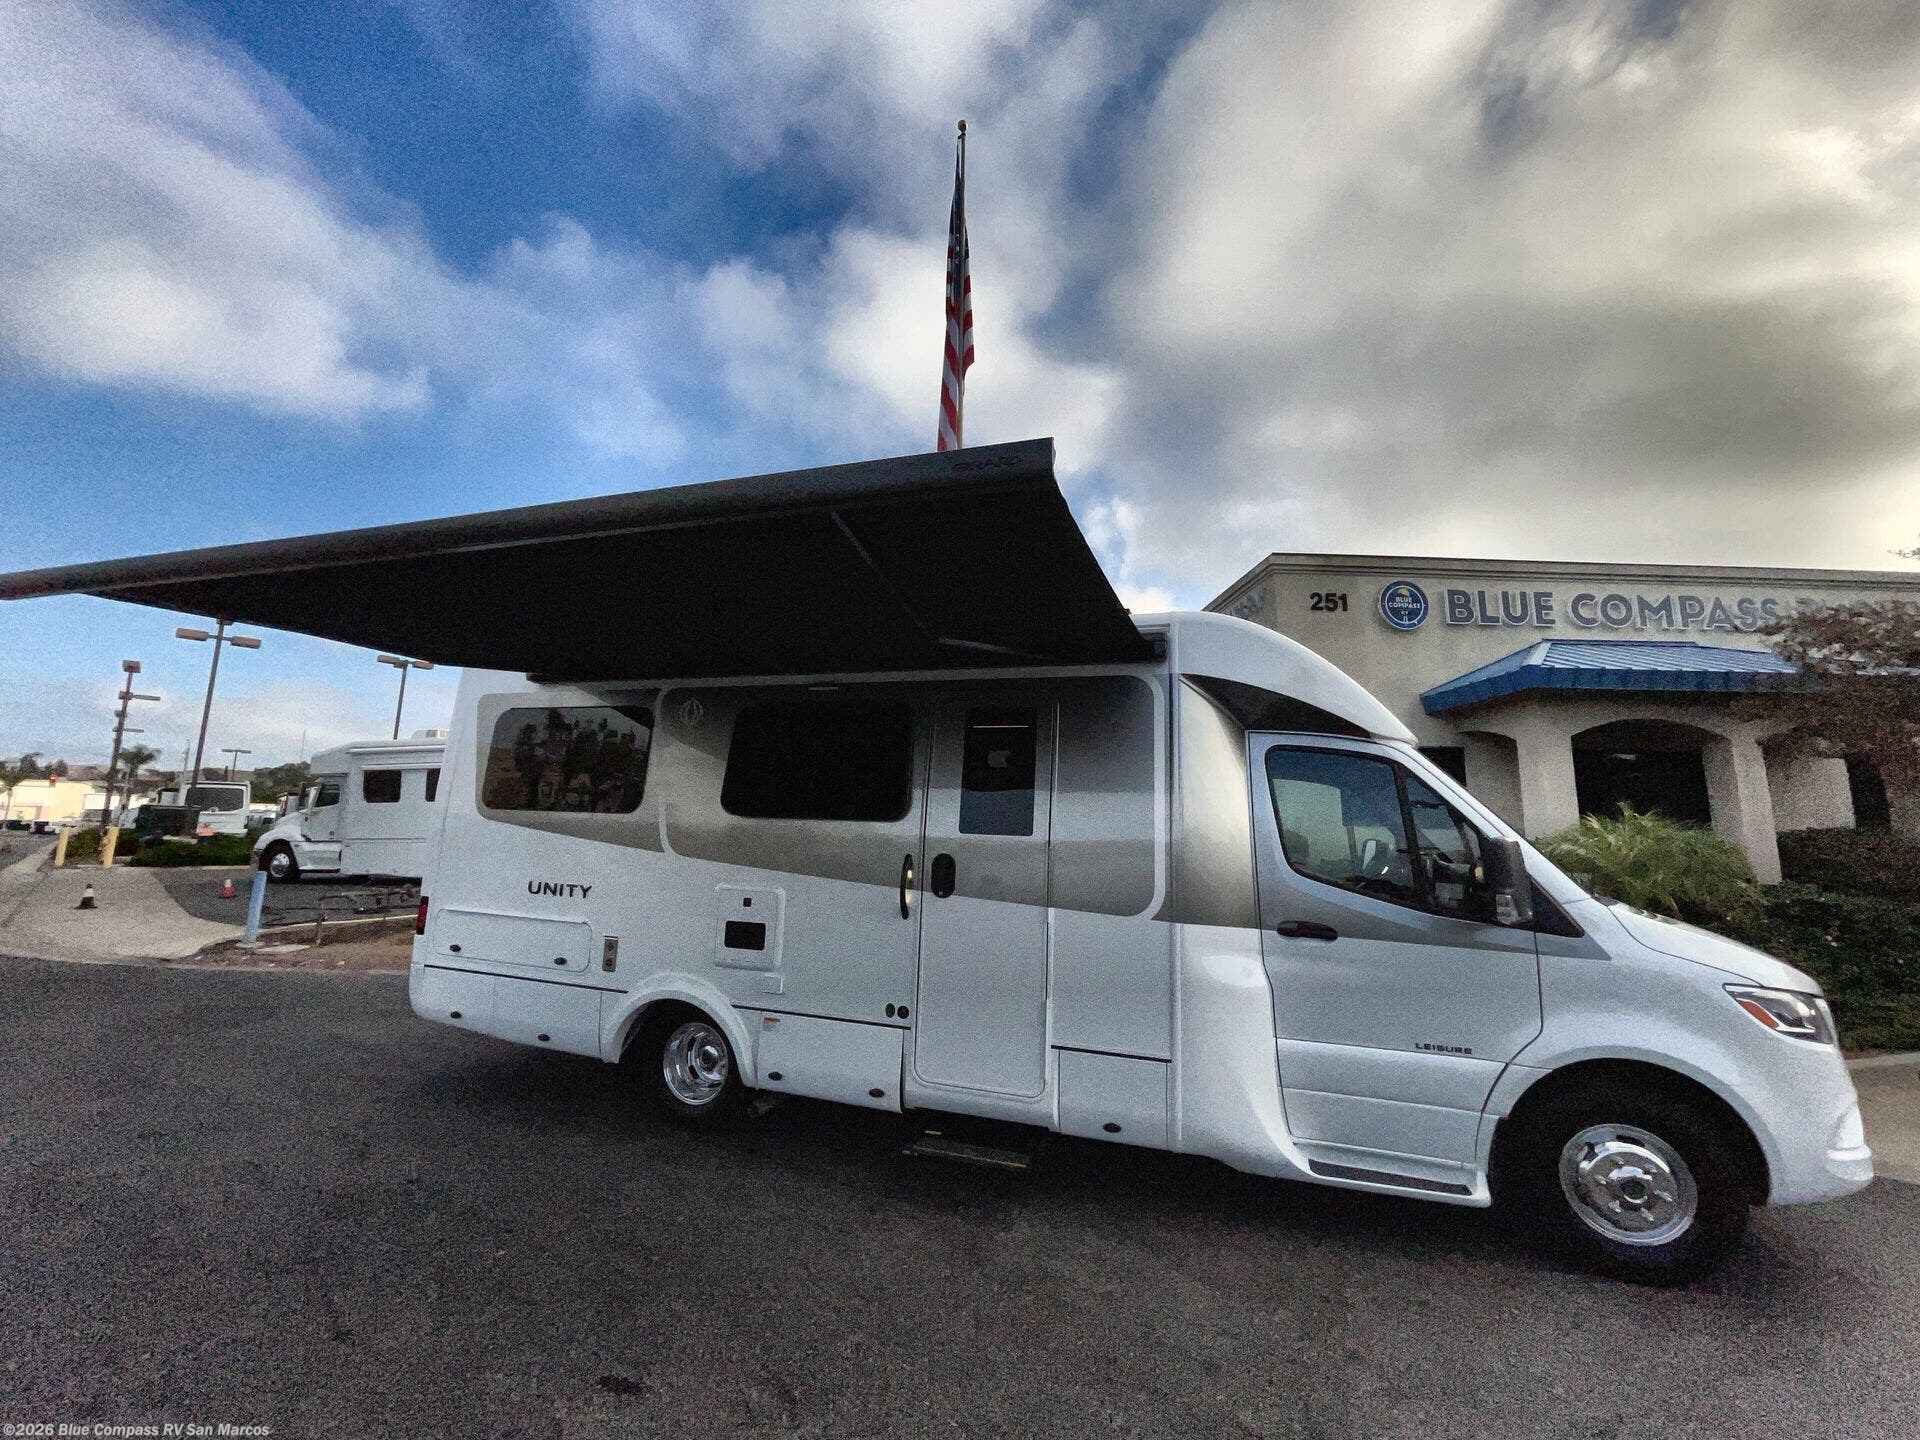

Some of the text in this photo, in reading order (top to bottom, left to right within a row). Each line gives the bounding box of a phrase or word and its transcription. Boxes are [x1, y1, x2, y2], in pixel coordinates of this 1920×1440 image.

[1309, 592, 1349, 612] 251
[1445, 588, 1556, 627] BLUE
[1569, 592, 1779, 632] COMPASS
[527, 880, 593, 899] UNITY
[1415, 1042, 1473, 1055] LEISURE
